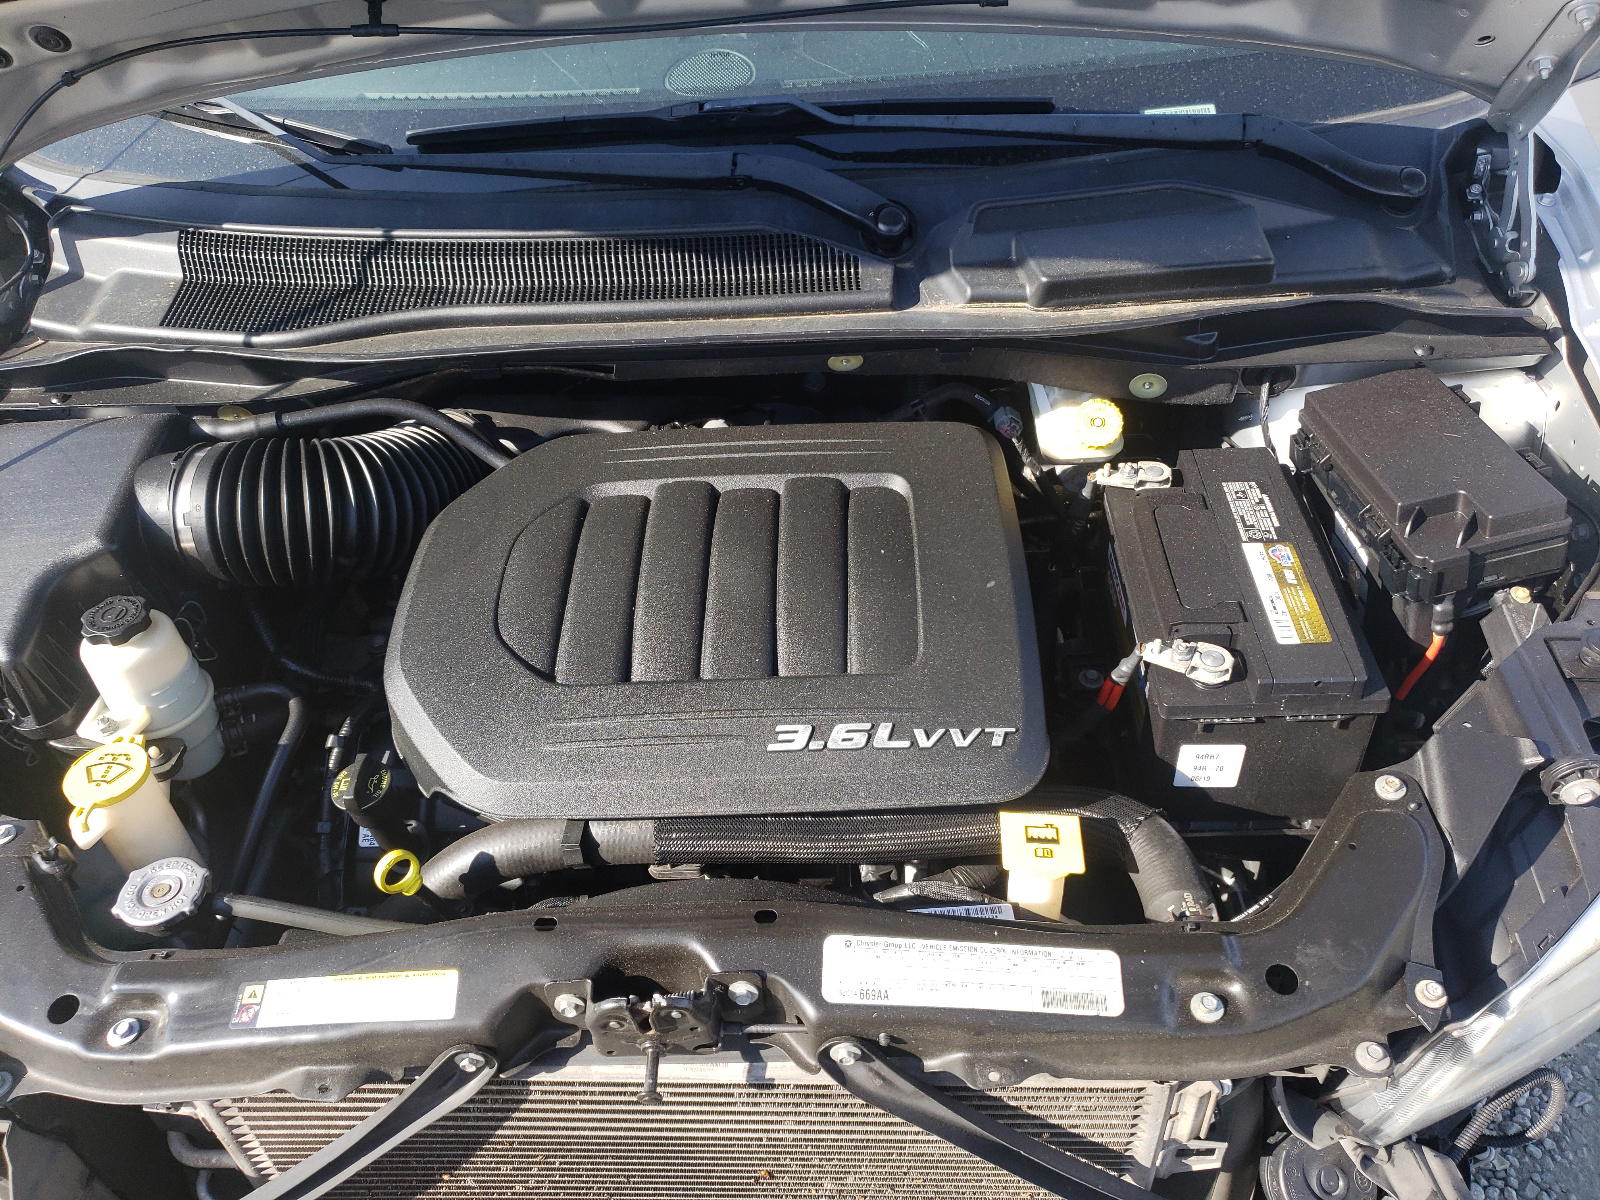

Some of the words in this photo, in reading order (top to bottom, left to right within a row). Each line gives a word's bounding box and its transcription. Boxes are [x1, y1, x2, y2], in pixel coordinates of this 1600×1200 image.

[767, 722, 913, 752] 3.6L
[913, 727, 1017, 748] VVT
[883, 941, 903, 950] Group
[920, 943, 947, 951] VEHICLE
[949, 944, 978, 953] EMISSION
[1011, 949, 1052, 957] INFORMATION
